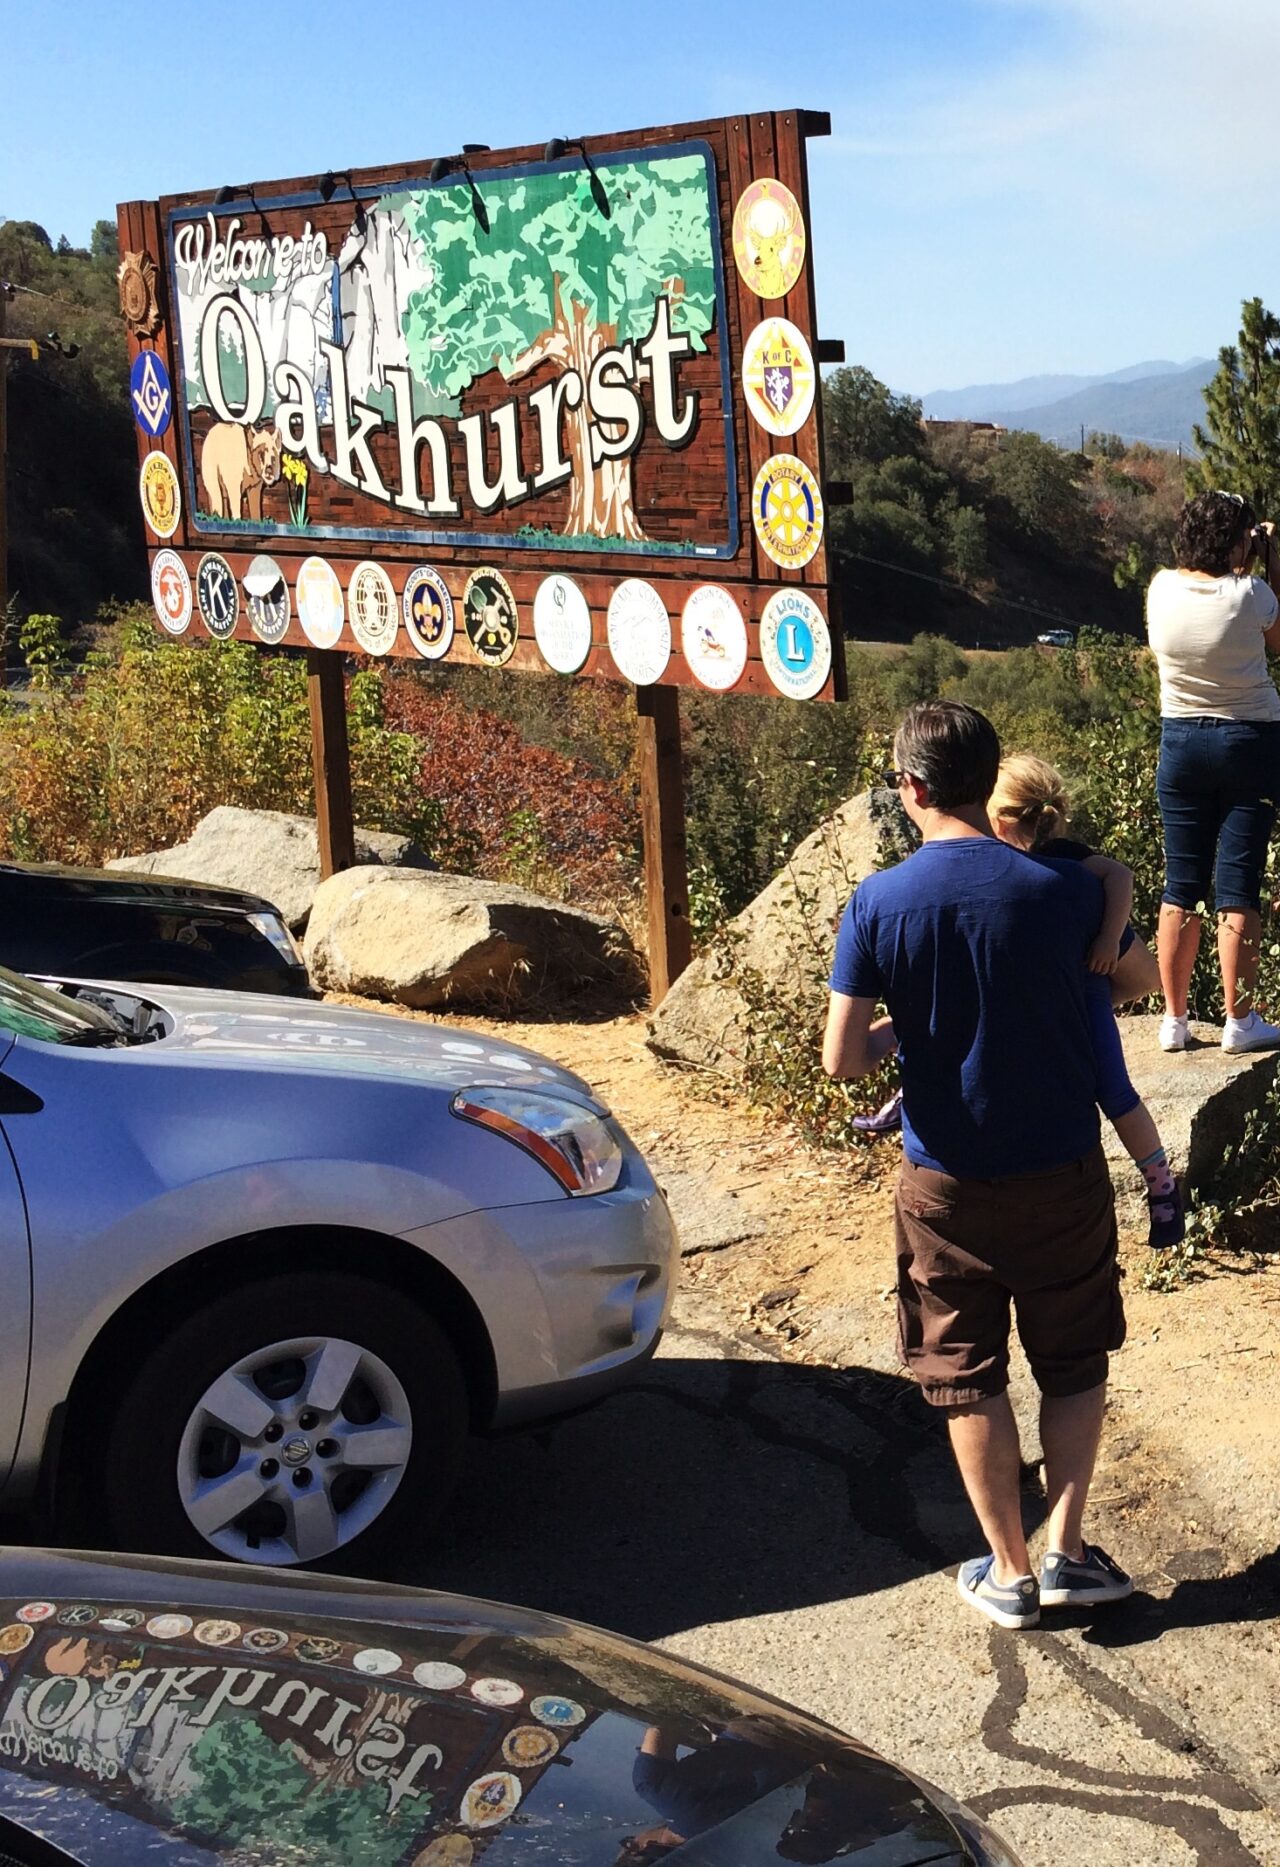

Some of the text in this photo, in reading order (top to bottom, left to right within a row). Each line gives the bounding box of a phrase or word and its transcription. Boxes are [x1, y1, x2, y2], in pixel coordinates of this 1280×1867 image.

[175, 212, 327, 296] Welcome to
[762, 350, 770, 364] K
[785, 349, 792, 363] C
[145, 381, 159, 411] G
[200, 294, 698, 516] Oakhurst
[770, 466, 799, 482] ROTARY
[201, 560, 229, 581] KIWANIS
[200, 588, 235, 631] INTERNATIONAL
[207, 570, 228, 621] K
[406, 569, 424, 594] SCOUTS
[435, 577, 453, 622] AMERICA
[776, 597, 812, 619] LIONS
[785, 624, 806, 661] L
